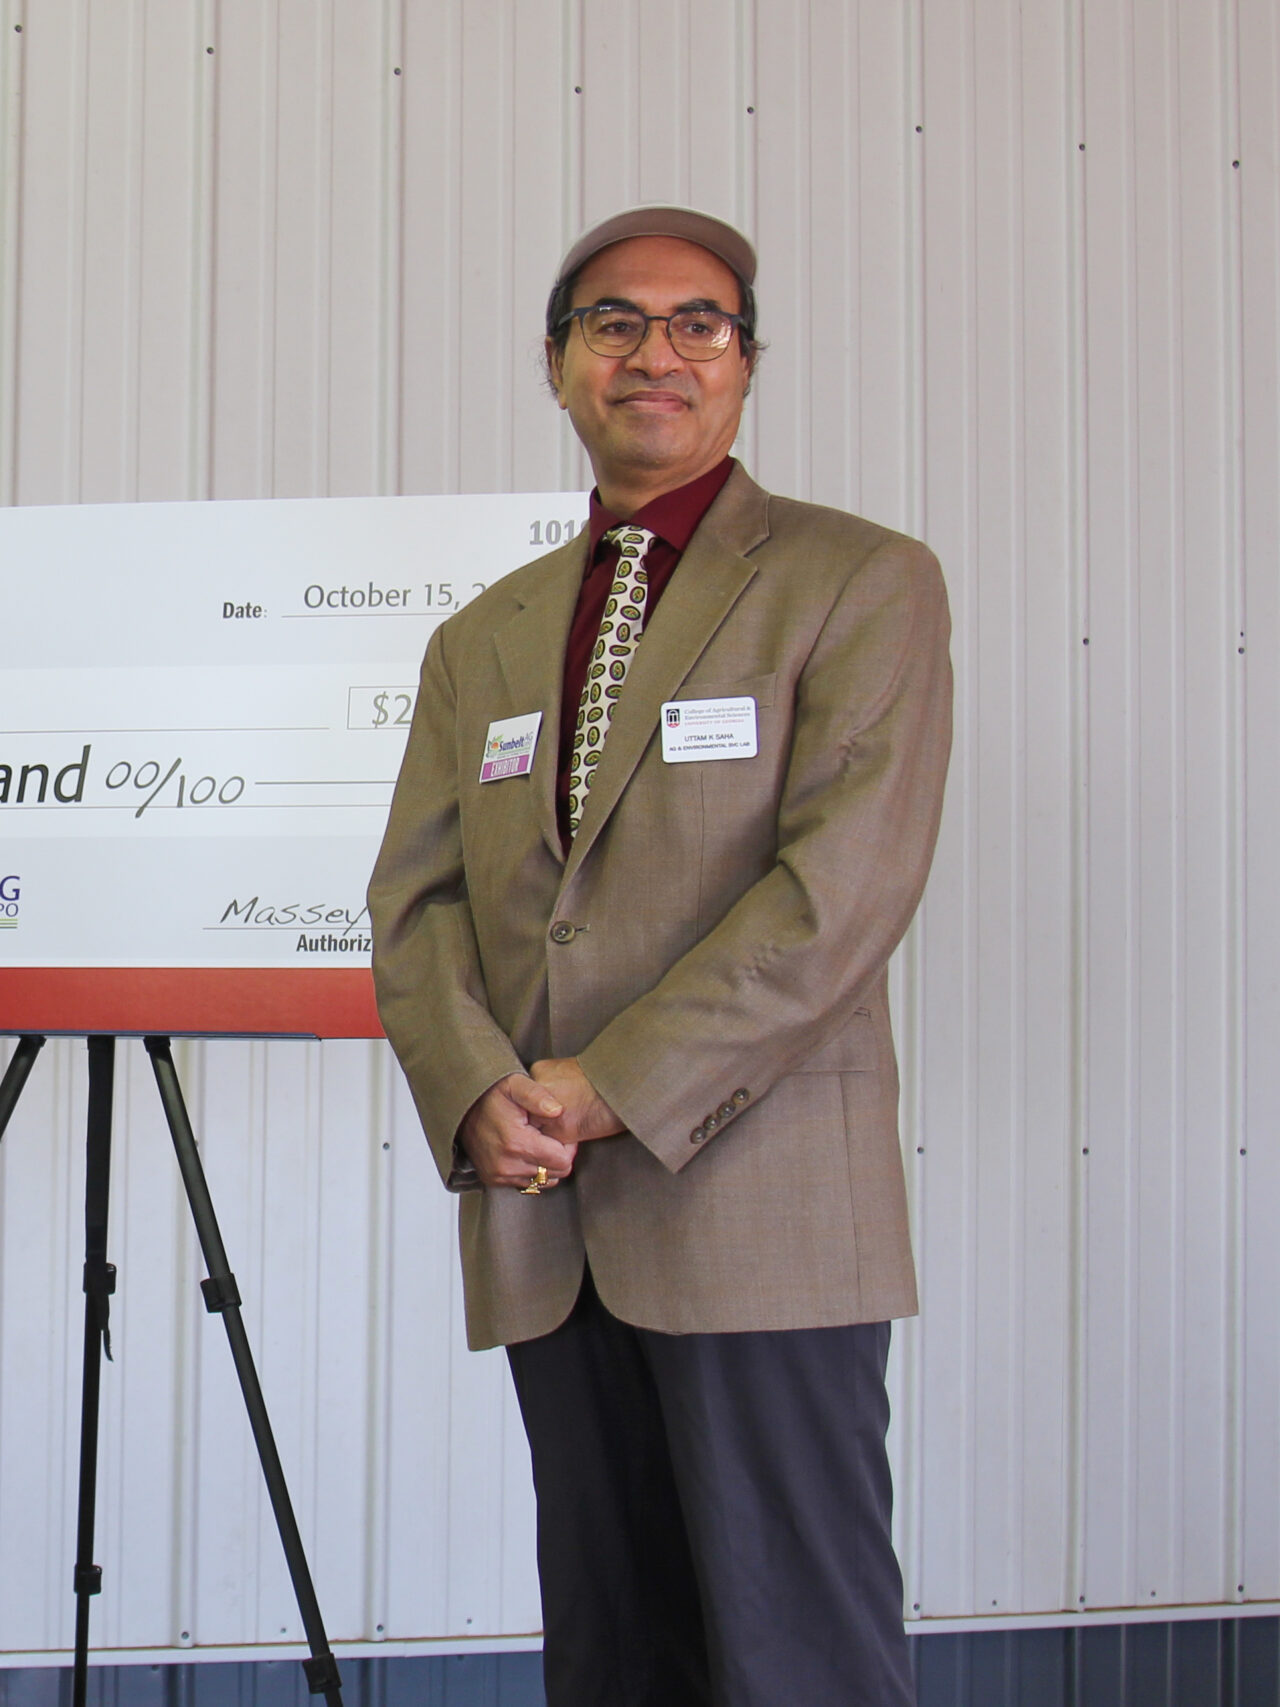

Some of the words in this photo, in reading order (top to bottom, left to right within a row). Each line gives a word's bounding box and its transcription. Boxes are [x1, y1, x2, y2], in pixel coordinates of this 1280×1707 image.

[529, 519, 589, 546] 101
[222, 600, 268, 620] Date:
[304, 582, 412, 609] October
[424, 583, 461, 611] 15,
[220, 896, 369, 936] Massey
